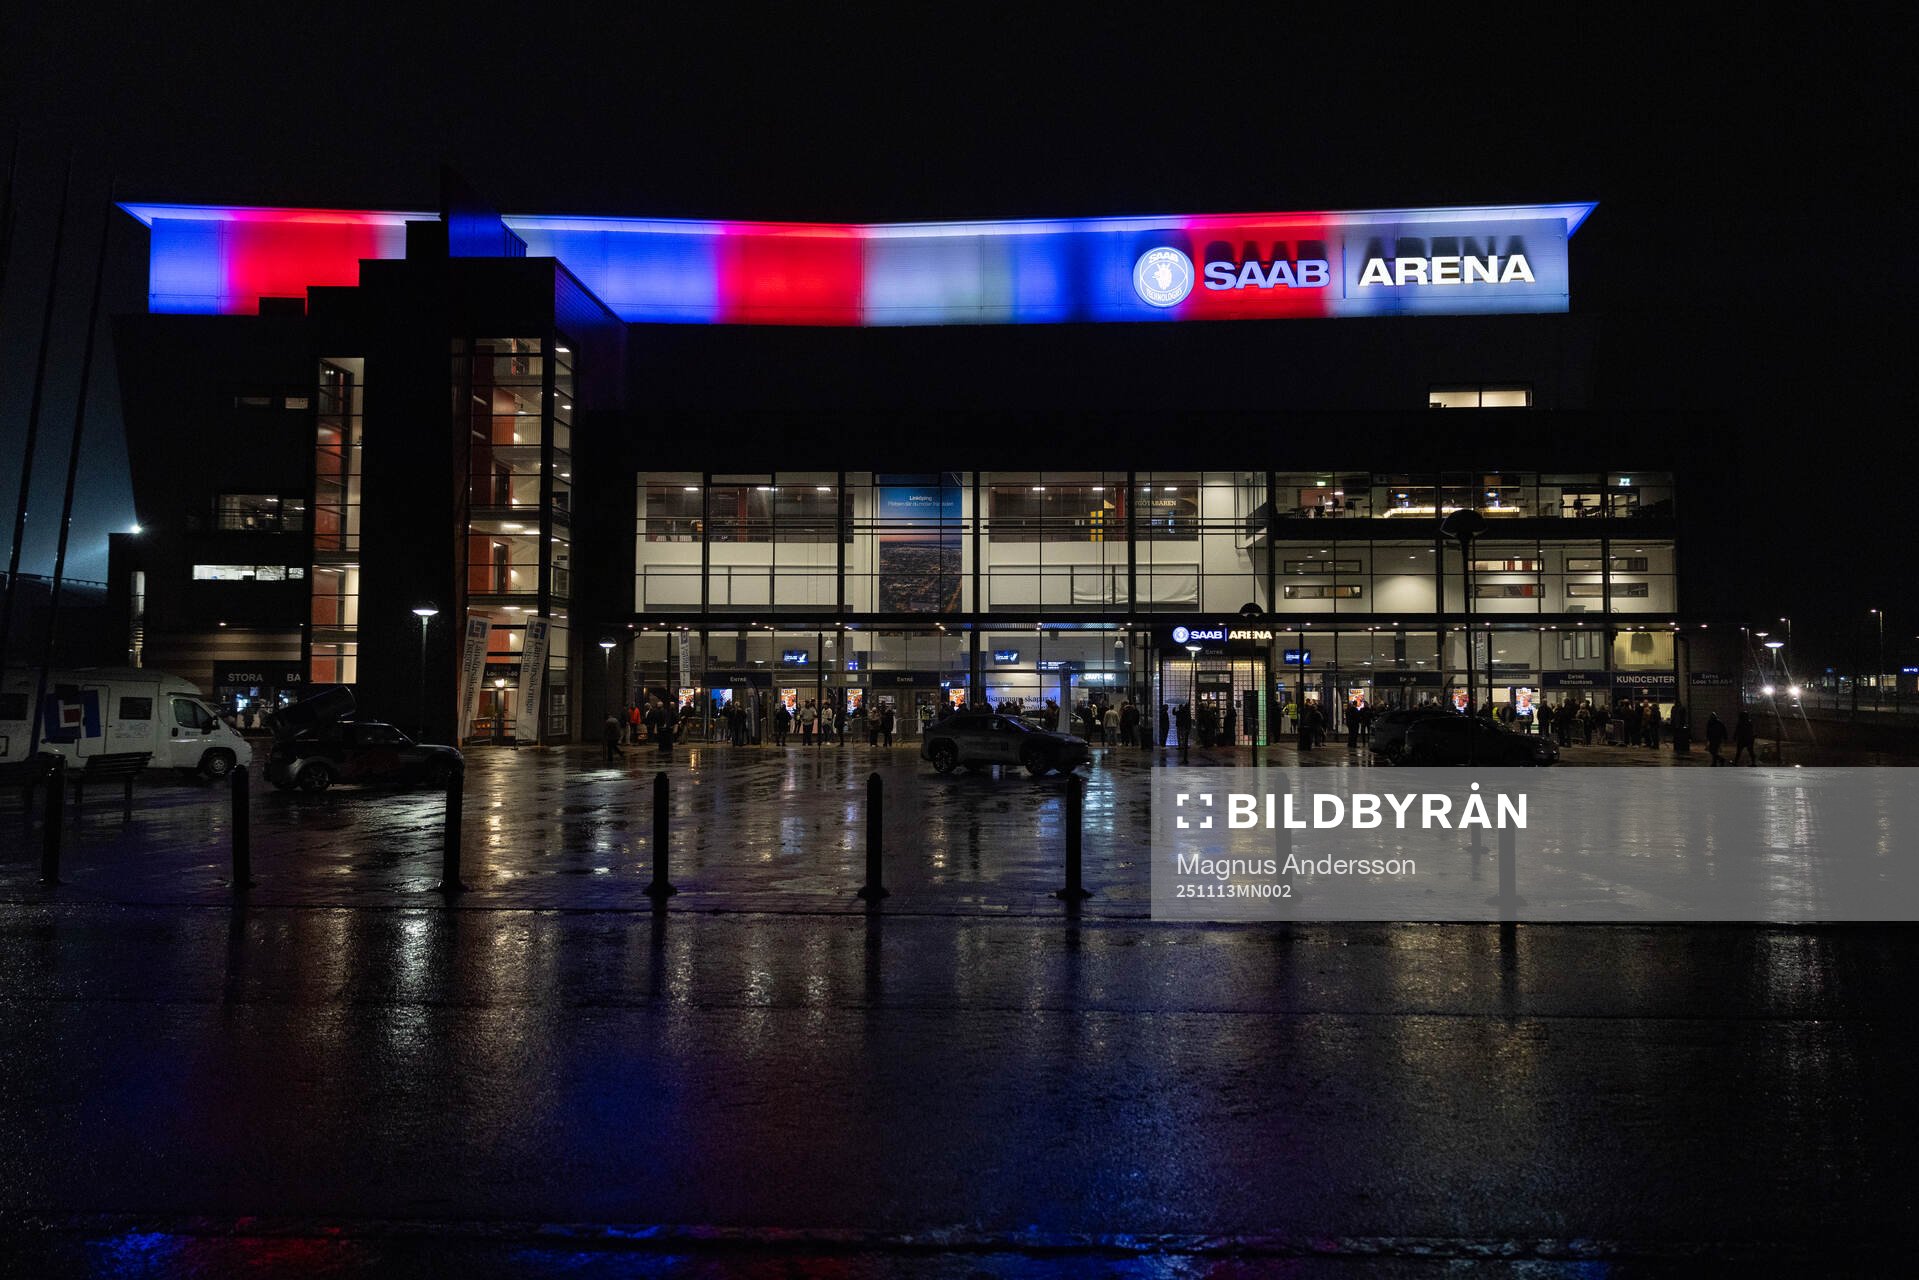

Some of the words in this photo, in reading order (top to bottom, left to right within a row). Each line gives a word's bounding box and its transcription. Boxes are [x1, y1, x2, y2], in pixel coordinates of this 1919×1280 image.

[1148, 251, 1179, 264] SAAB
[1204, 259, 1330, 291] SAAB
[1358, 254, 1536, 287] ARENA
[1190, 630, 1223, 640] SAAB
[1228, 630, 1273, 640] ARENA
[228, 673, 264, 682] STORA
[1616, 675, 1676, 683] KUNDCENTER
